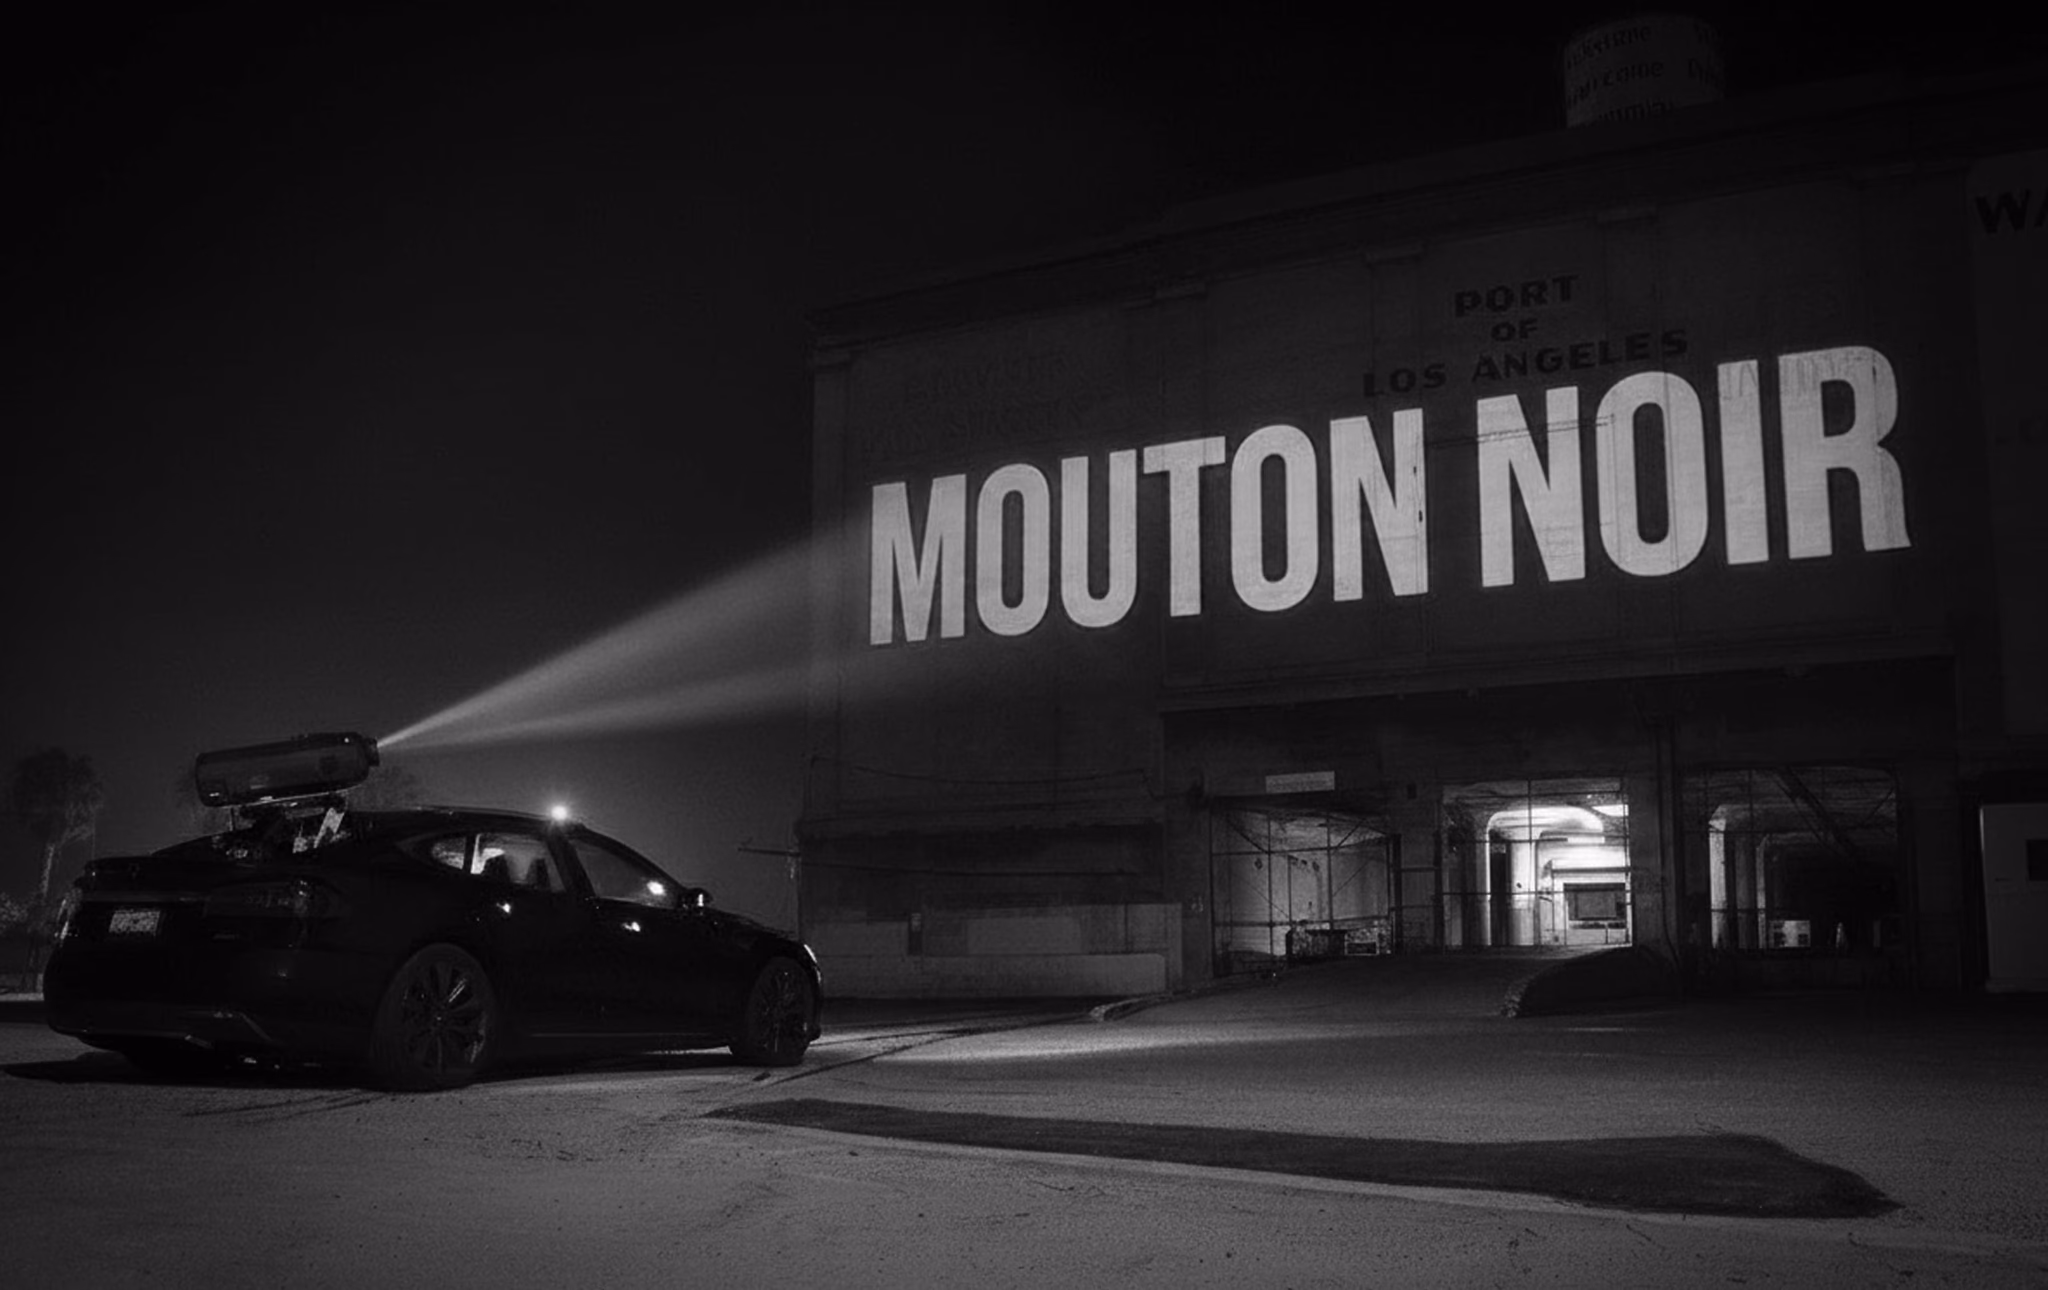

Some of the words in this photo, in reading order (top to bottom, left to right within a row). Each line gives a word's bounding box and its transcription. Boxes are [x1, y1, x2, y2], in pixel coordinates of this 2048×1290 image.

[1454, 274, 1579, 318] PORT
[1490, 317, 1539, 343] OF
[1363, 362, 1447, 398] LOS
[1471, 329, 1689, 383] ANGELES
[870, 408, 1429, 645] MOUTON
[1476, 346, 1910, 588] NOIR
